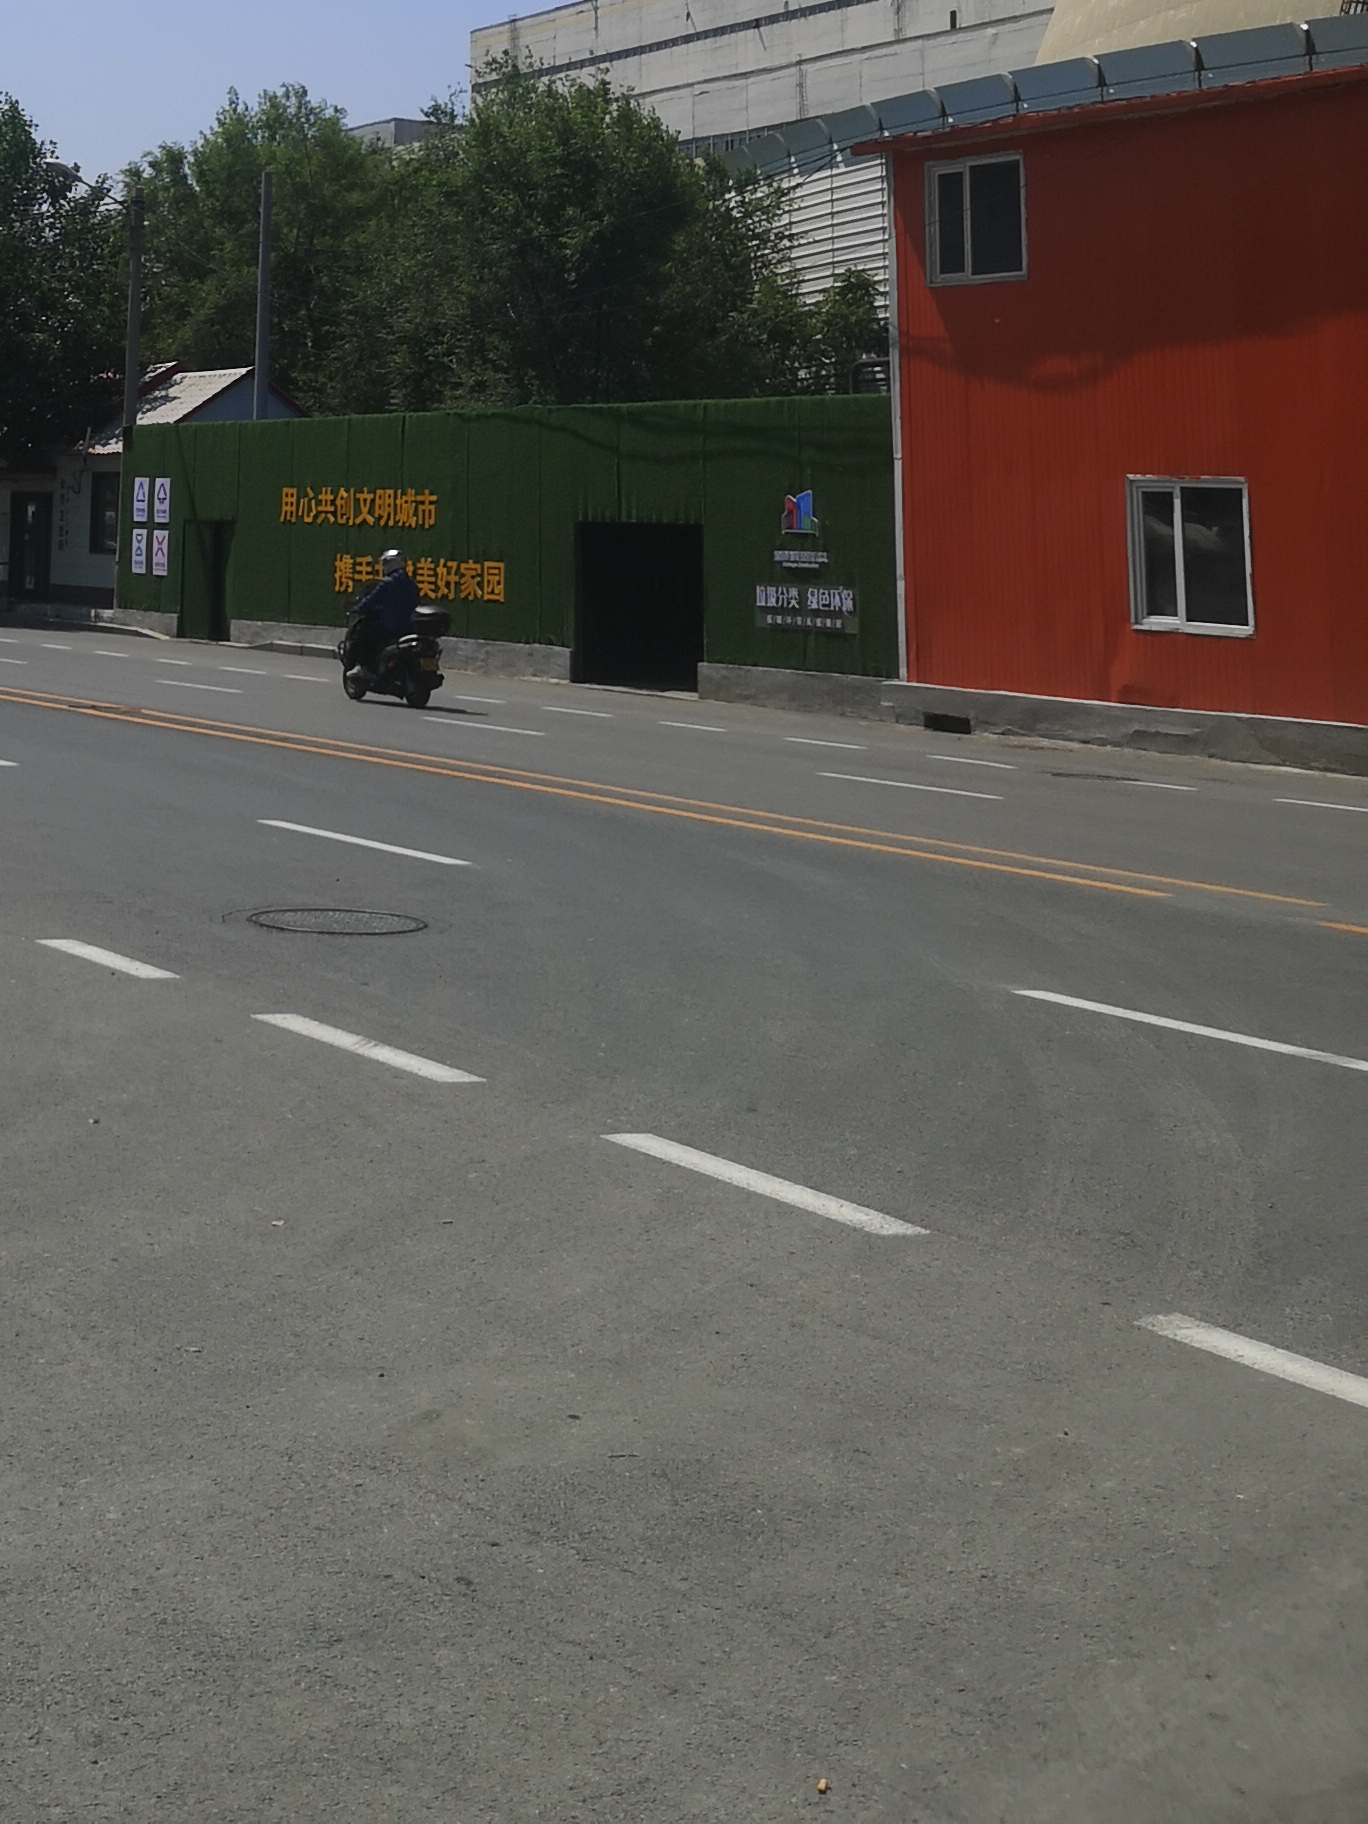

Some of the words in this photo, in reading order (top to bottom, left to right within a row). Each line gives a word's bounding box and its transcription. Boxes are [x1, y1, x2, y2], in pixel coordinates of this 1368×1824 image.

[280, 487, 438, 528] 用心共创文明城市
[334, 553, 505, 603] 携手美好家园
[755, 585, 800, 609] 垃圾分类
[807, 587, 854, 612] 绿色环保
